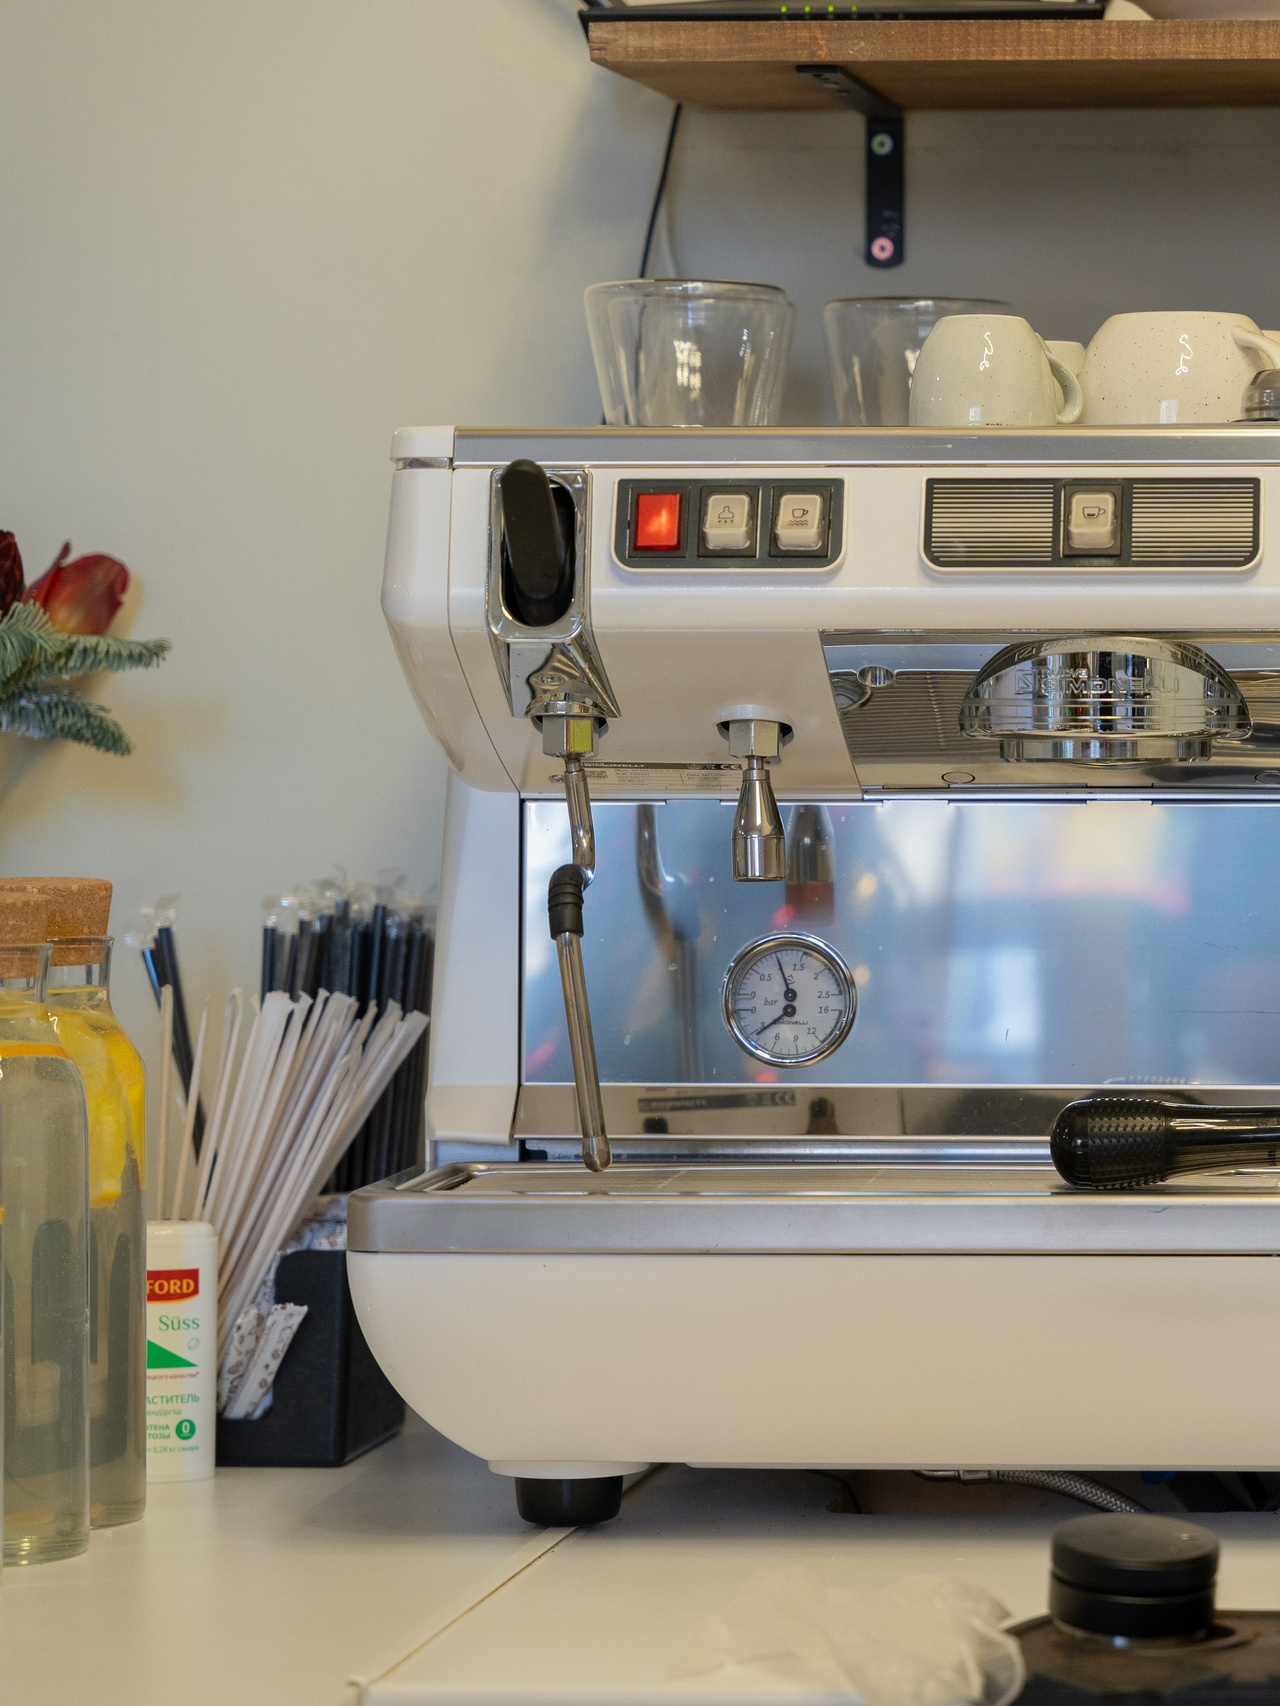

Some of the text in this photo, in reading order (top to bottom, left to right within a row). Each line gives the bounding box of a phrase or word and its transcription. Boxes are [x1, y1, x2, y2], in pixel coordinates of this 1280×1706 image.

[793, 963, 805, 971] 1.5
[760, 973, 772, 981] 0.5
[817, 991, 830, 999] 2.5
[764, 997, 778, 1006] bar
[818, 1006, 829, 1014] 16
[807, 1027, 817, 1035] 12
[793, 1035, 798, 1043] 9
[147, 1279, 195, 1295] FORD
[159, 1315, 200, 1331] Süss
